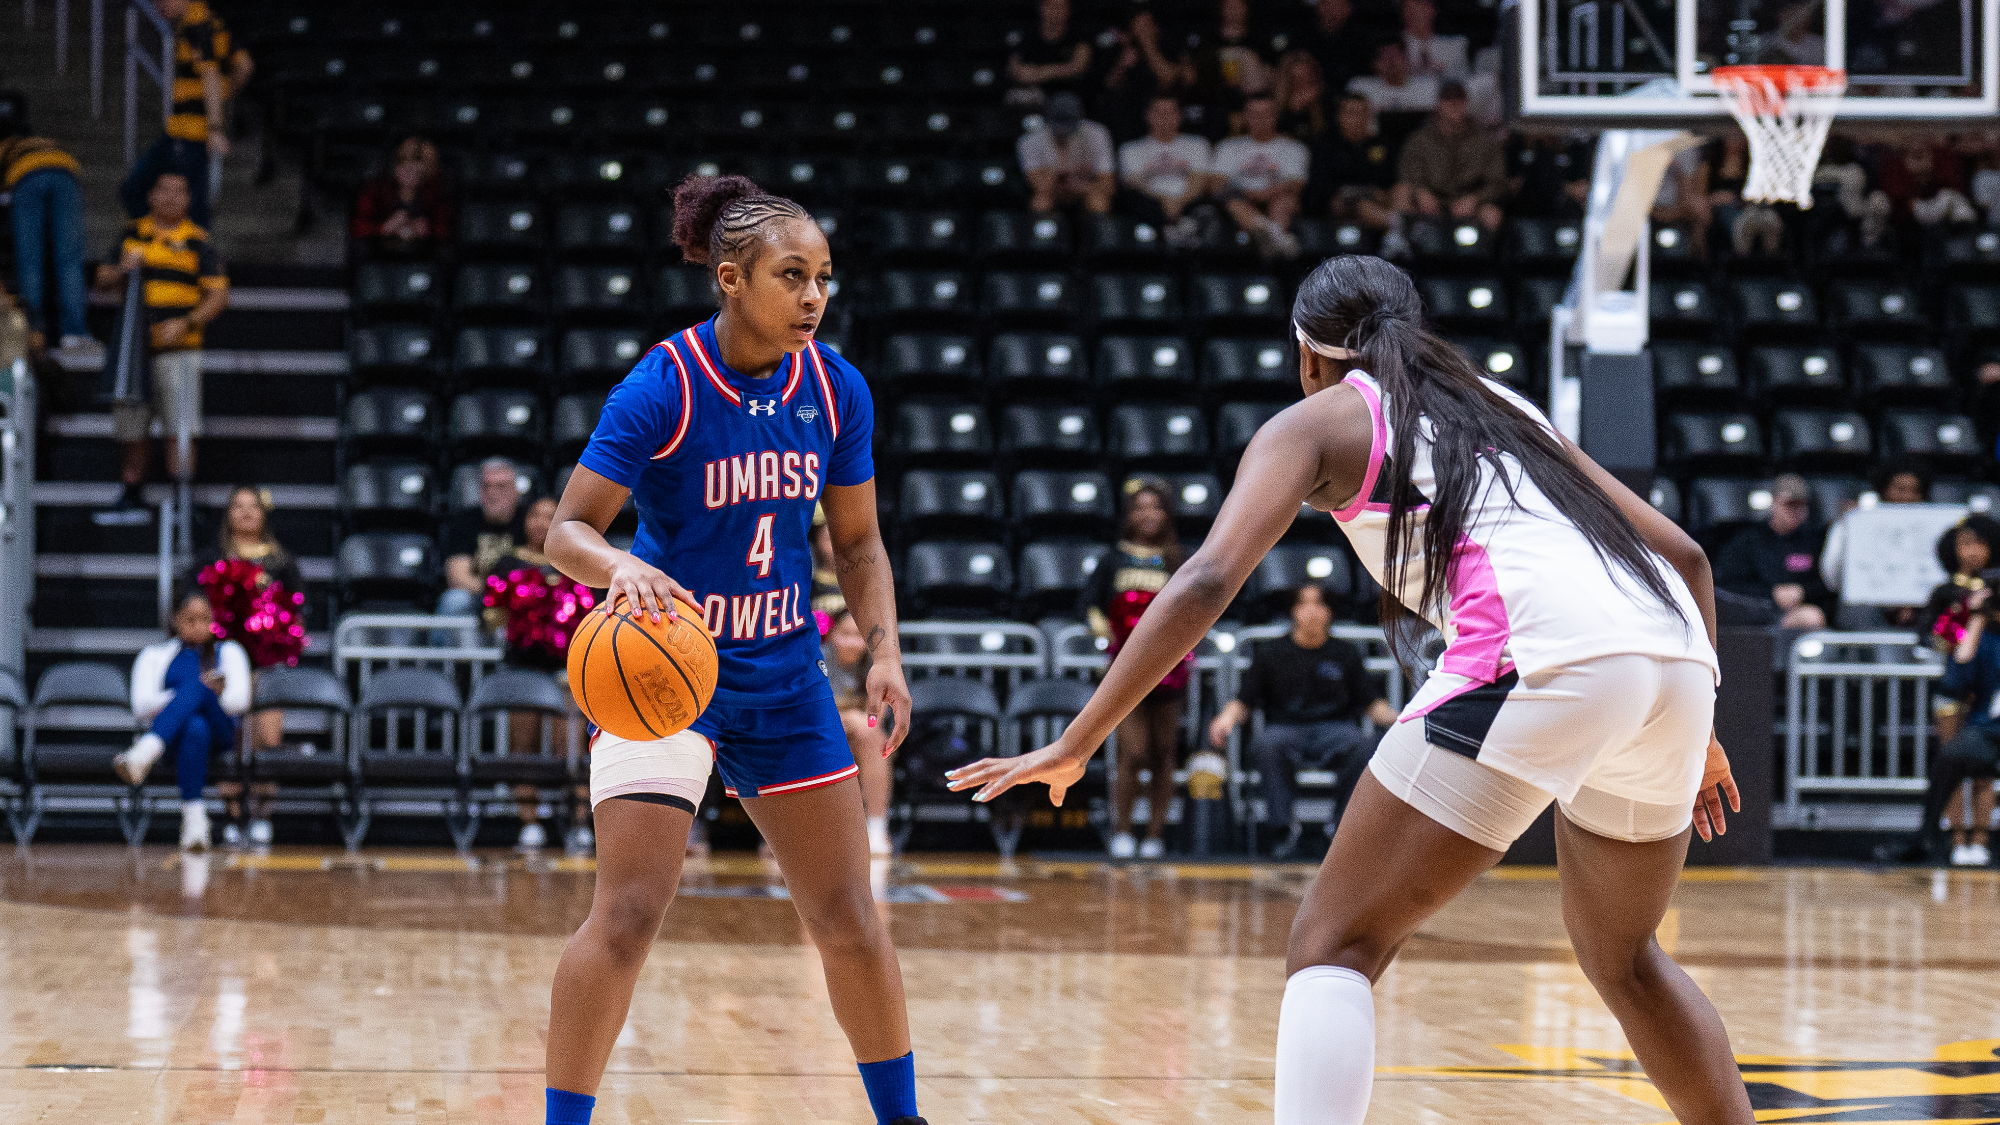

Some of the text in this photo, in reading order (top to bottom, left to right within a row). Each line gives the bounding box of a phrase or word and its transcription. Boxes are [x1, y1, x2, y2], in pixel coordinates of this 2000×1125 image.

[704, 450, 819, 509] UMASS
[746, 513, 776, 578] 4
[688, 582, 805, 640] OWELL
[638, 664, 689, 726] NCAA
